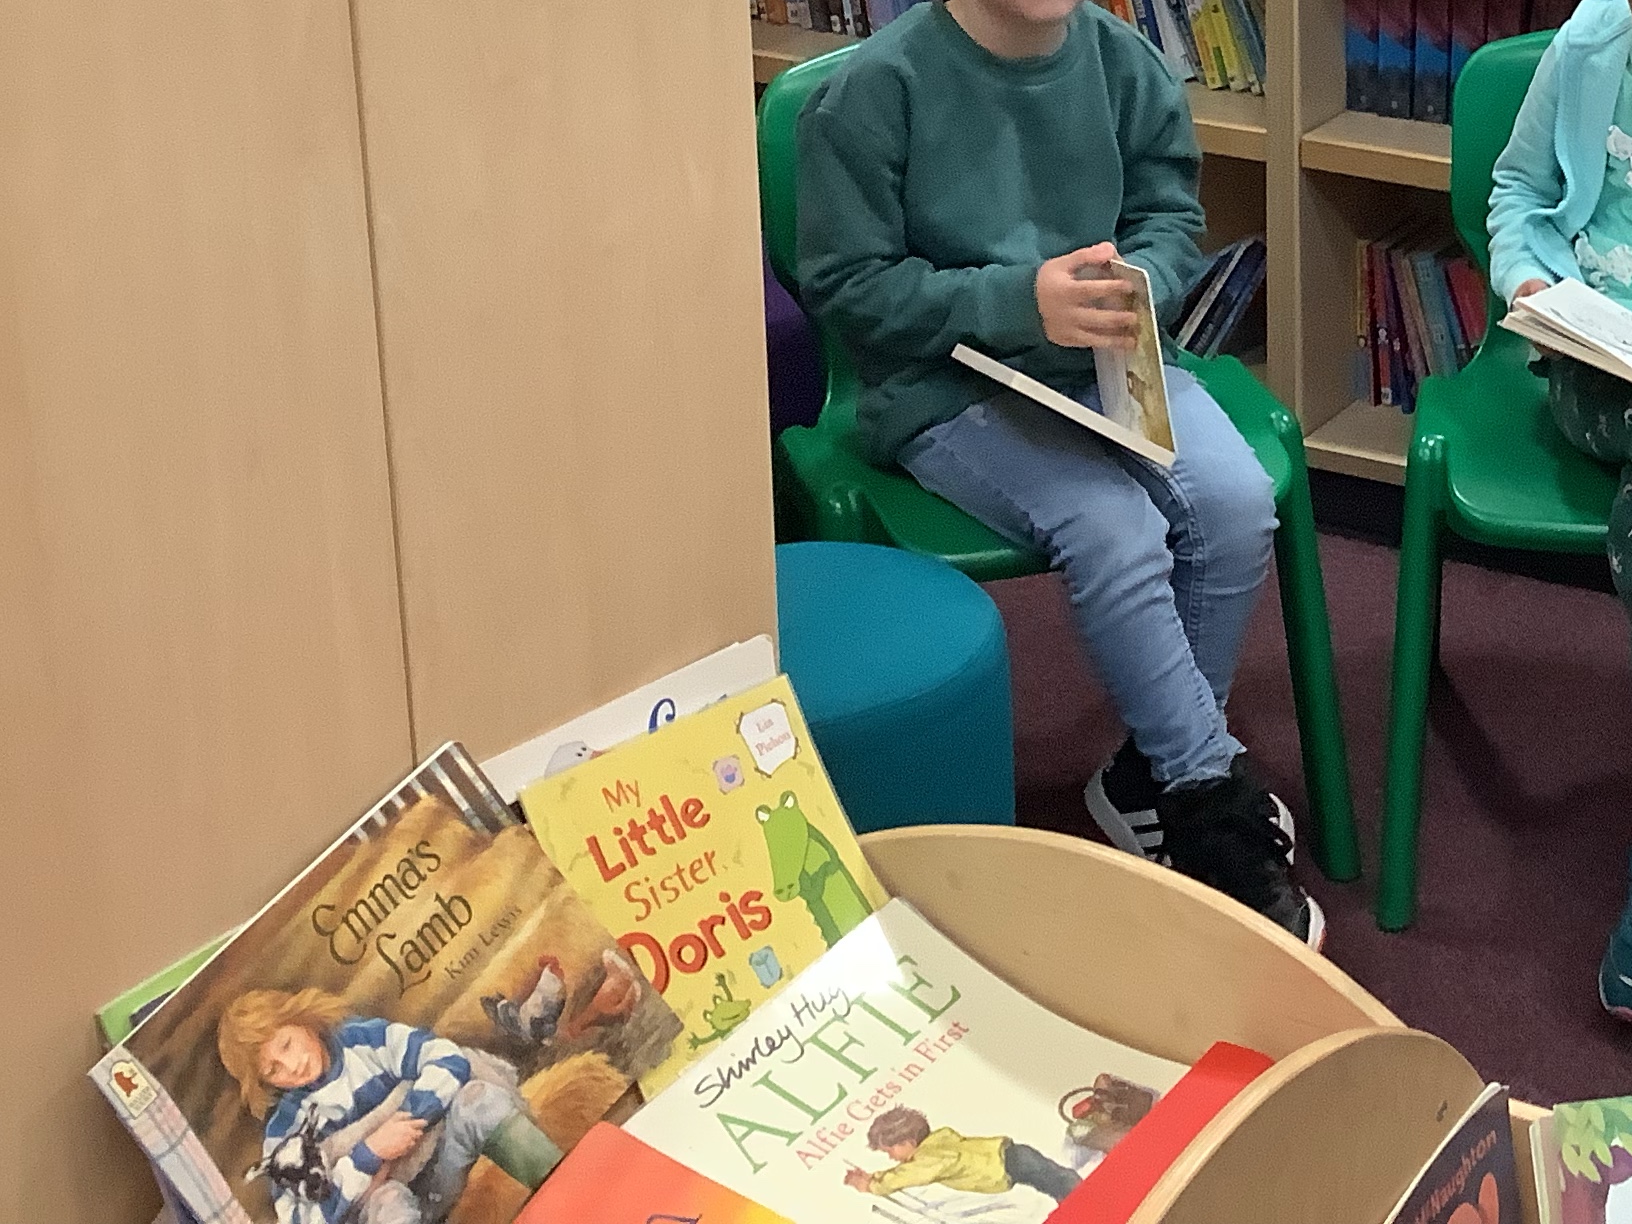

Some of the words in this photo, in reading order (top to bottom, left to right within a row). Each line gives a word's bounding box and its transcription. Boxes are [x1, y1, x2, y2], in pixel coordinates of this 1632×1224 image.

[586, 794, 711, 883] Little
[601, 779, 641, 813] My
[311, 840, 442, 965] Emma's
[624, 850, 716, 922] Sister
[376, 891, 473, 999] Lamb
[444, 945, 481, 980] Kim
[478, 904, 523, 947] Lewis
[616, 890, 772, 995] Doris
[694, 1025, 805, 1109] Shirley
[716, 954, 961, 1175] ALFIE
[795, 1121, 855, 1171] Alfie
[846, 1080, 903, 1123] Gets
[890, 1060, 925, 1085] in
[913, 1021, 970, 1064] First
